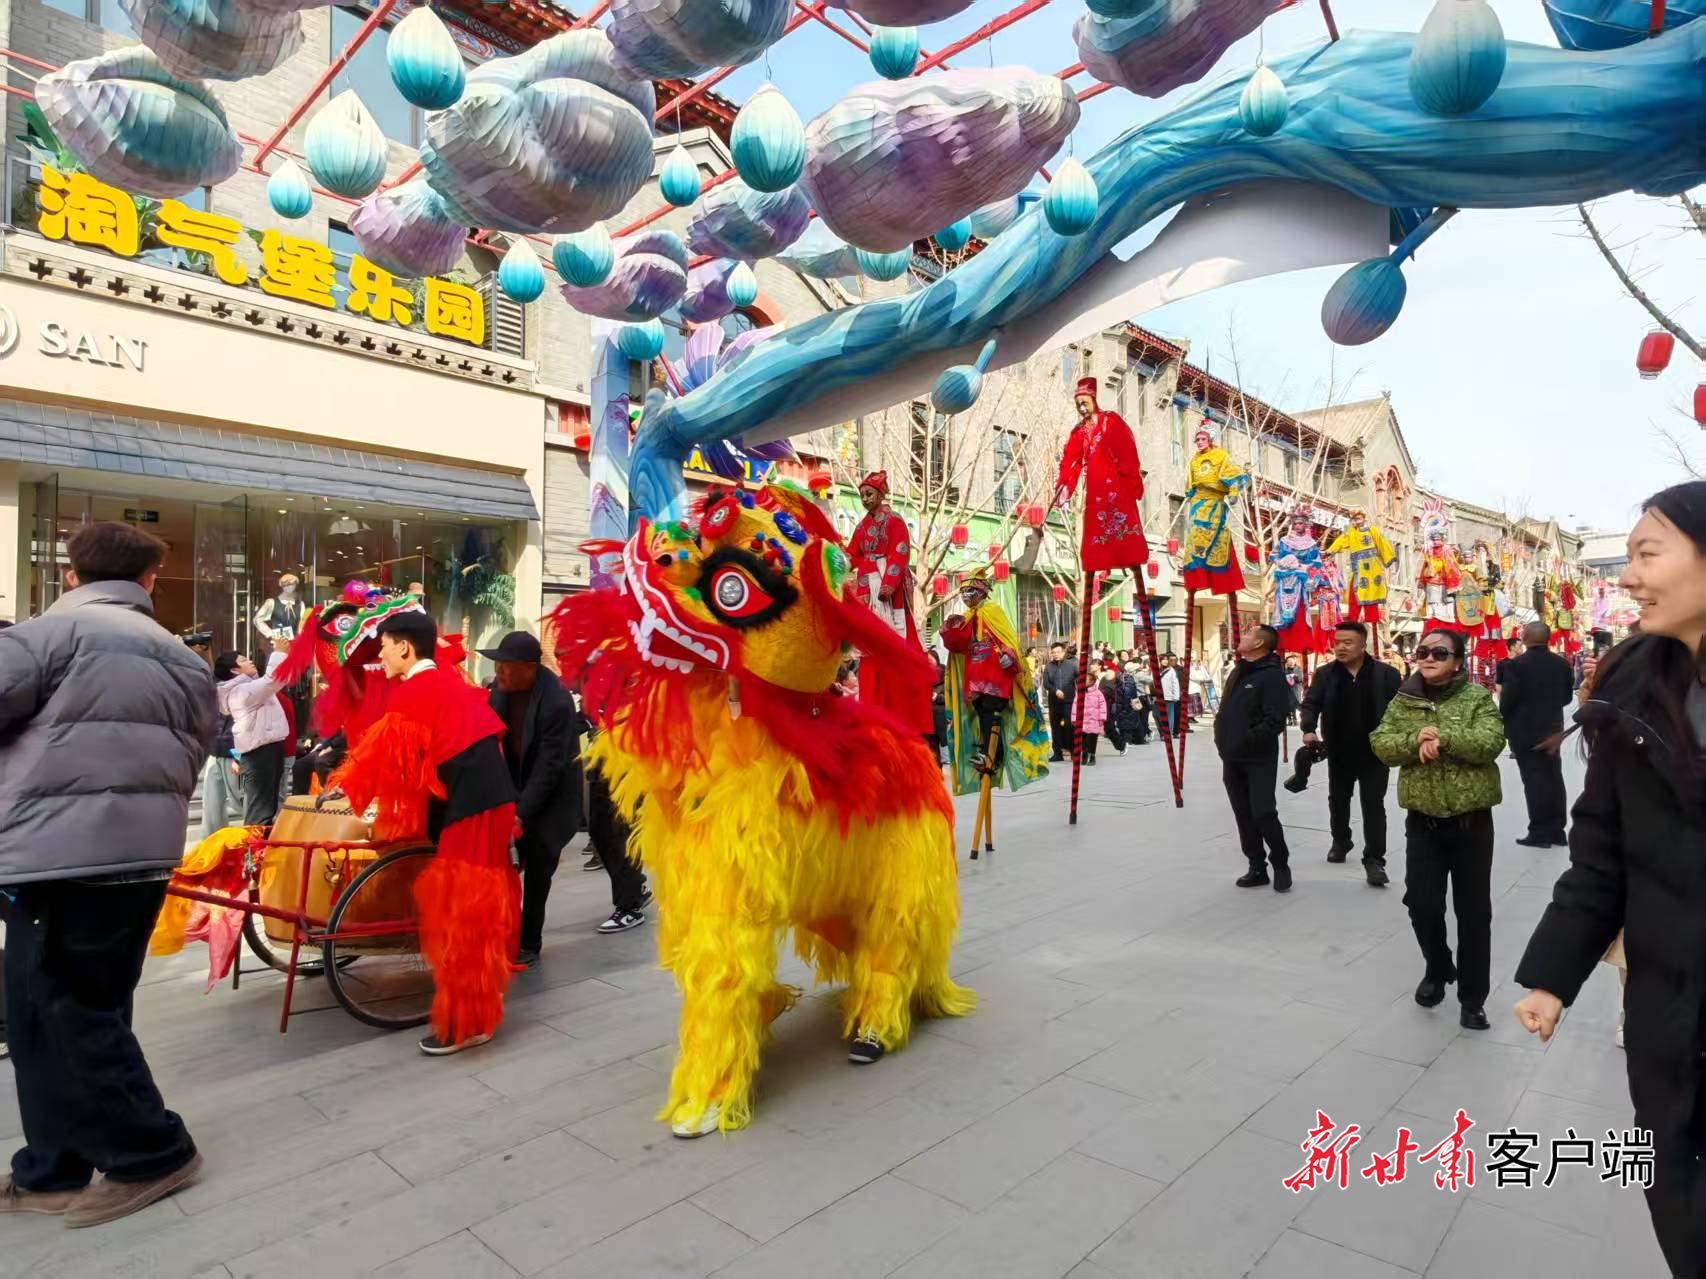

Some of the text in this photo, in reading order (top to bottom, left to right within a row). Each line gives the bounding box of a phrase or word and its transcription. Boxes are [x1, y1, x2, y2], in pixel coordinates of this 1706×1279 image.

[38, 164, 485, 346] 淘气堡乐园
[39, 320, 148, 373] SAN
